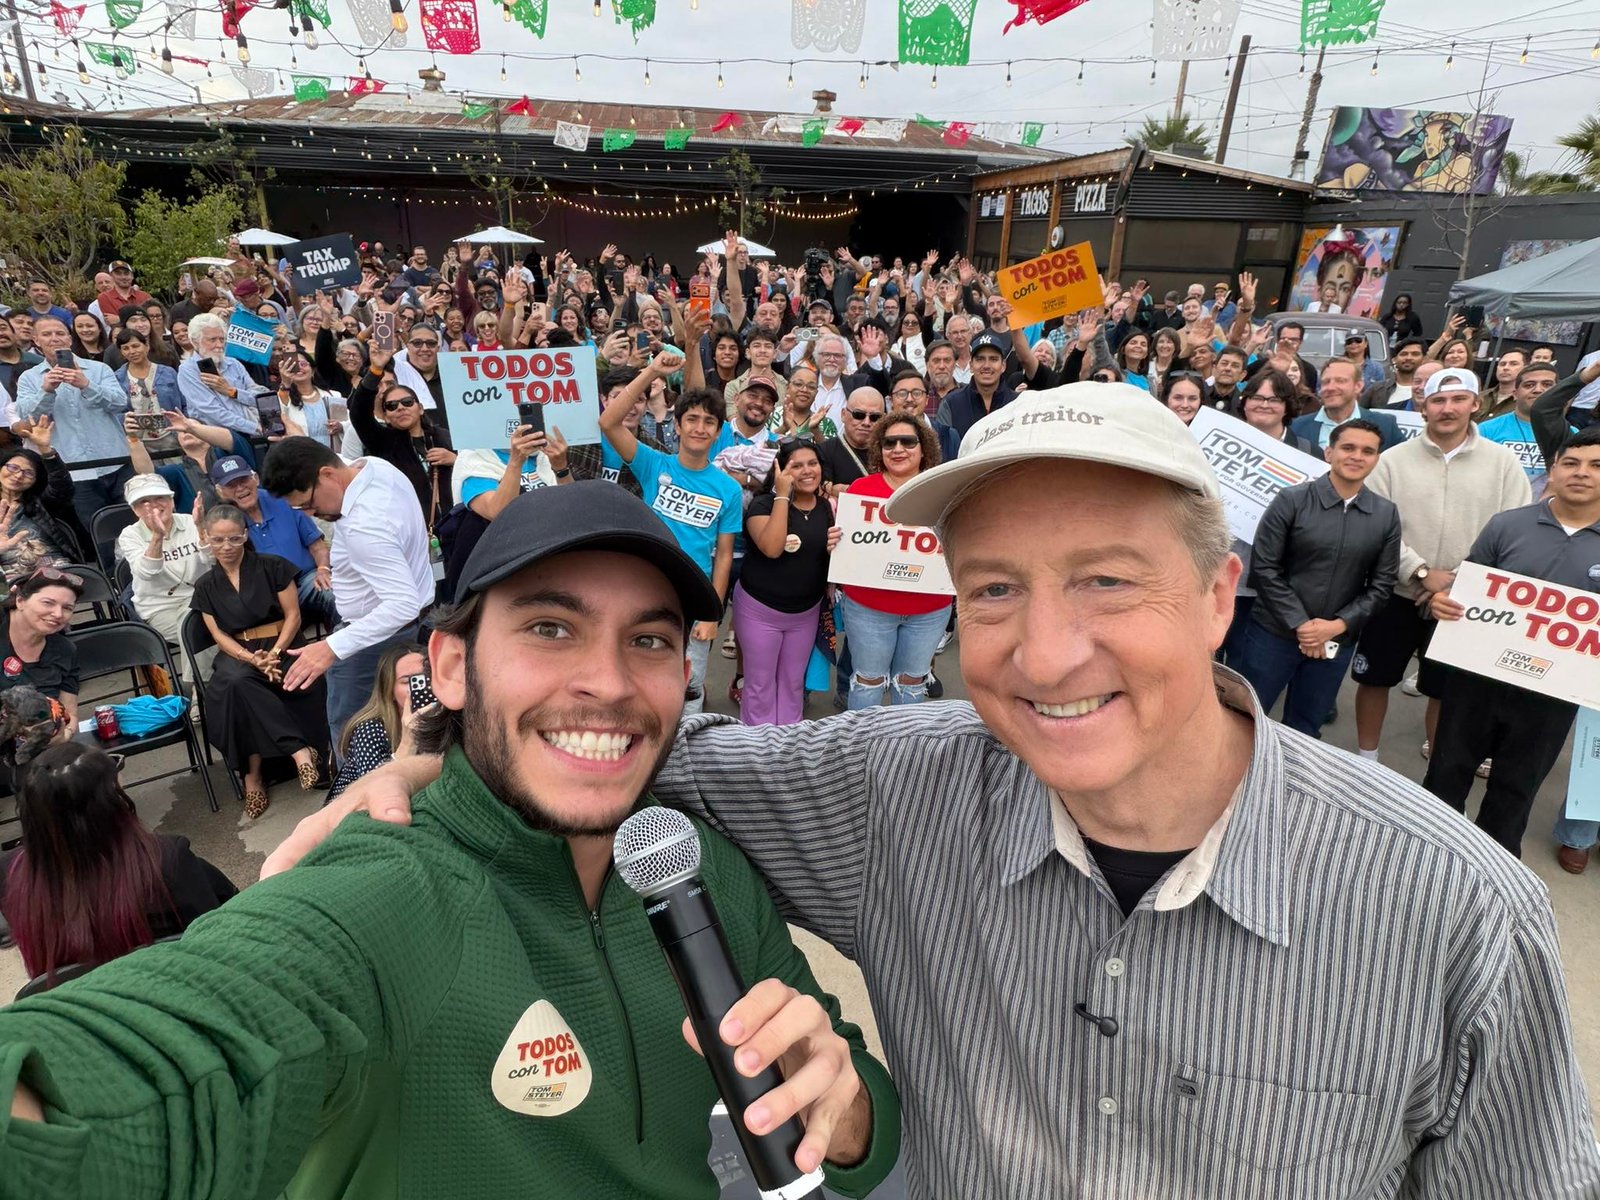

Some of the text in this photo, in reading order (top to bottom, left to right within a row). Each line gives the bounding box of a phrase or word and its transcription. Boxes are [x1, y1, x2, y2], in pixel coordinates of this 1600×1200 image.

[1020, 189, 1050, 215] TACOS
[1074, 183, 1107, 212] PIZZA
[302, 247, 335, 264] TAX
[1010, 249, 1080, 284] TODOS
[296, 257, 351, 278] TRUMP
[1013, 265, 1087, 300] con TOM
[228, 332, 268, 350] STEYER
[231, 325, 255, 338] TOM
[460, 352, 575, 381] TODOS
[462, 379, 582, 406] con TOM
[1021, 405, 1104, 426] traitor
[1210, 433, 1265, 468] TOM
[1505, 442, 1537, 453] TOM
[661, 485, 696, 505] TOM
[1235, 482, 1272, 505] GOVERNO
[163, 542, 199, 562] RSITY
[851, 530, 944, 554] con TO
[886, 570, 919, 578] STEYER
[1486, 573, 1600, 627] TODO
[1466, 606, 1517, 626] con
[1501, 657, 1545, 674] STEYER
[1505, 651, 1532, 663] TOM
[517, 1032, 575, 1062] TODOS
[508, 1051, 582, 1079] con TOM
